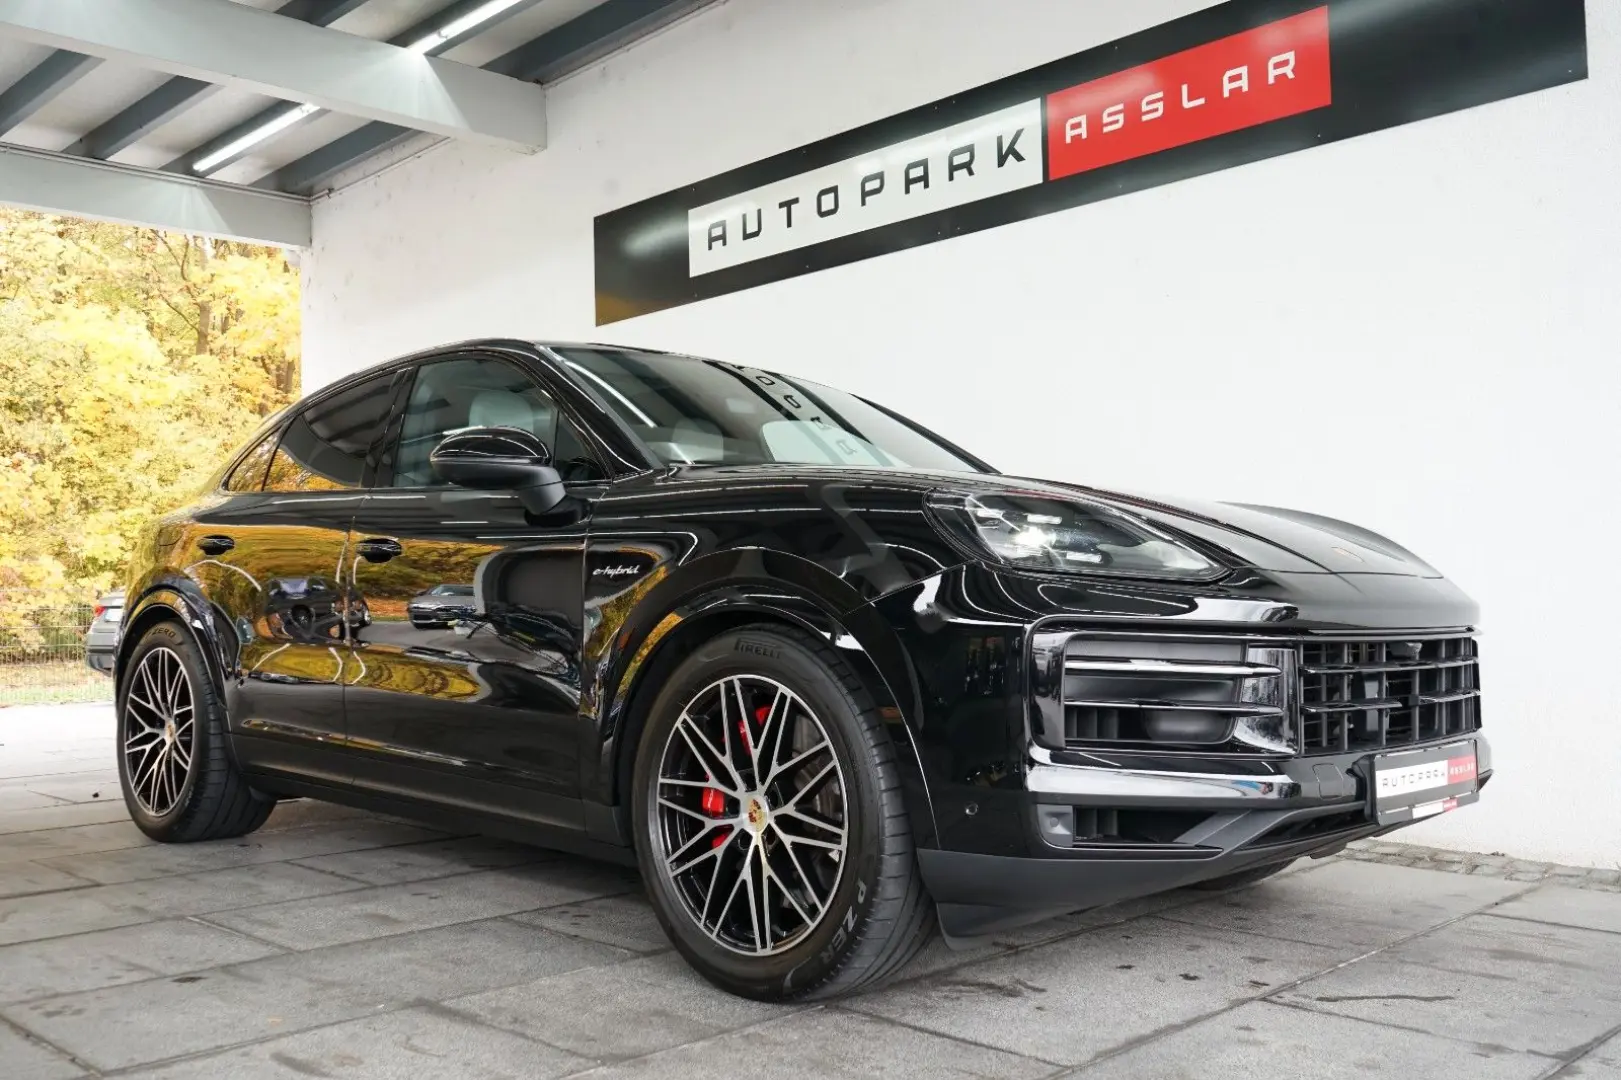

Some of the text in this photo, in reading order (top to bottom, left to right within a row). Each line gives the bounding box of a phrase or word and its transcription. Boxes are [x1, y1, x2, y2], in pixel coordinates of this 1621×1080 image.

[707, 50, 1296, 251] AUTOPARK ASSLAR
[592, 564, 640, 578] e-hybrid
[152, 627, 177, 639] ZERO
[734, 638, 781, 659] PIRELLI
[820, 905, 858, 964] ZER
